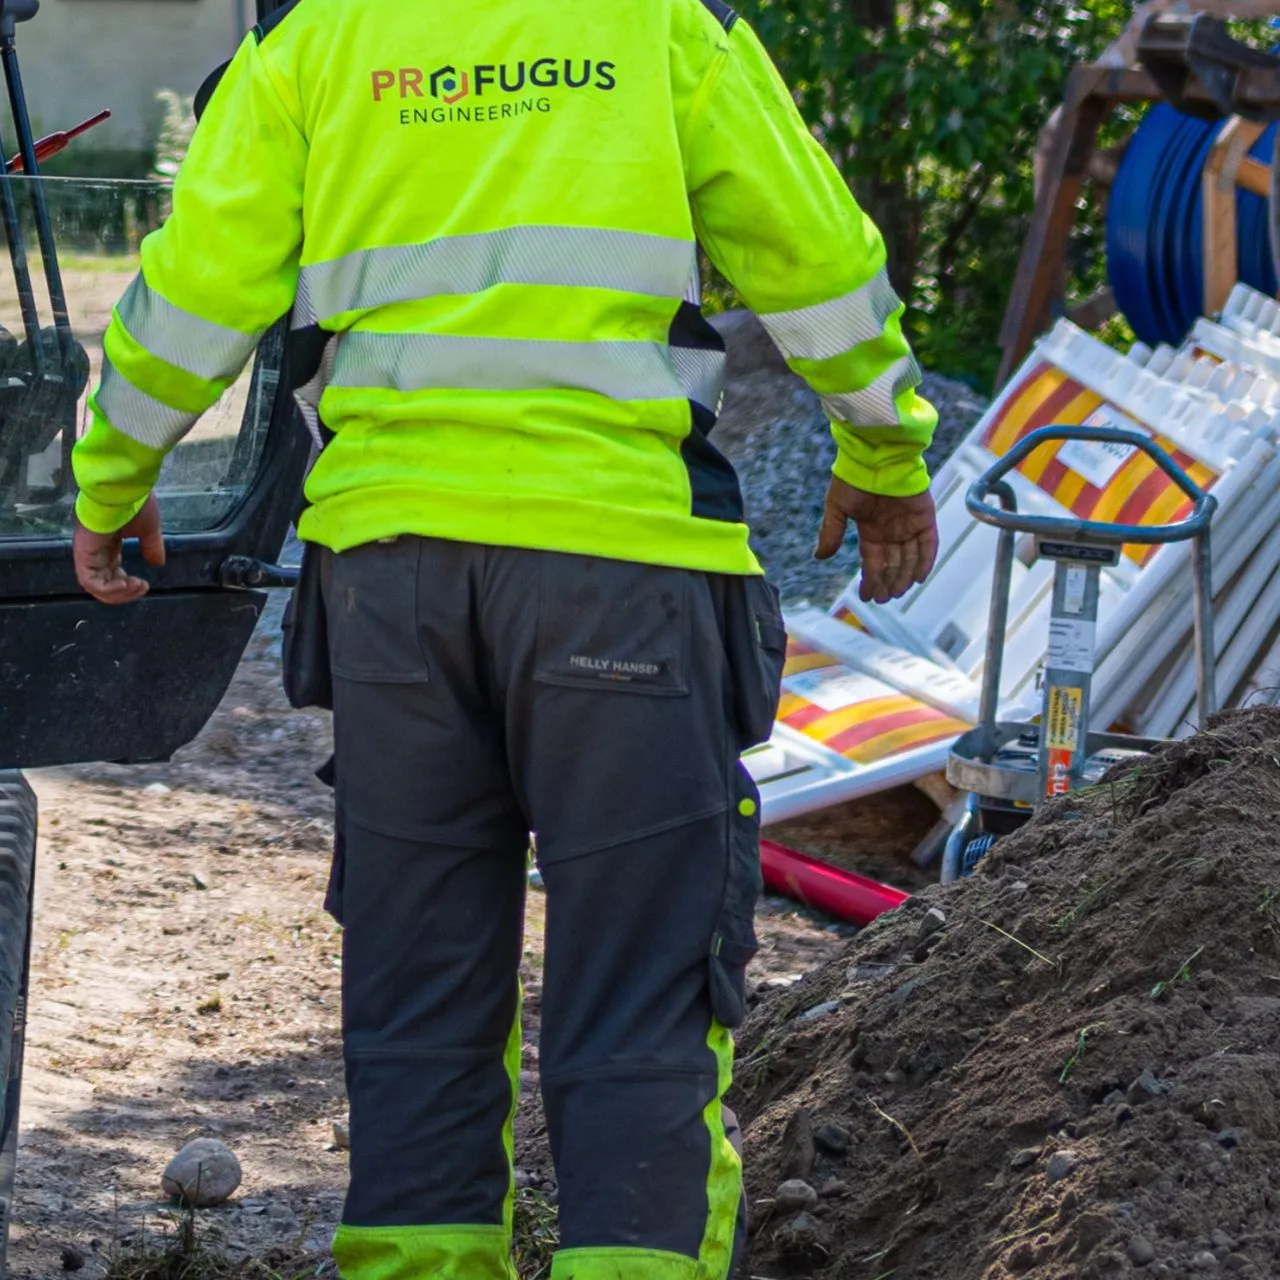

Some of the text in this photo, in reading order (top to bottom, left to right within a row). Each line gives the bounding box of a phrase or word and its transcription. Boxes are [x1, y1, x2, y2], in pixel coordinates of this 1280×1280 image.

[371, 58, 616, 104] PROFUGUS
[399, 97, 551, 125] ENGINEERING
[569, 653, 609, 671] HELLY
